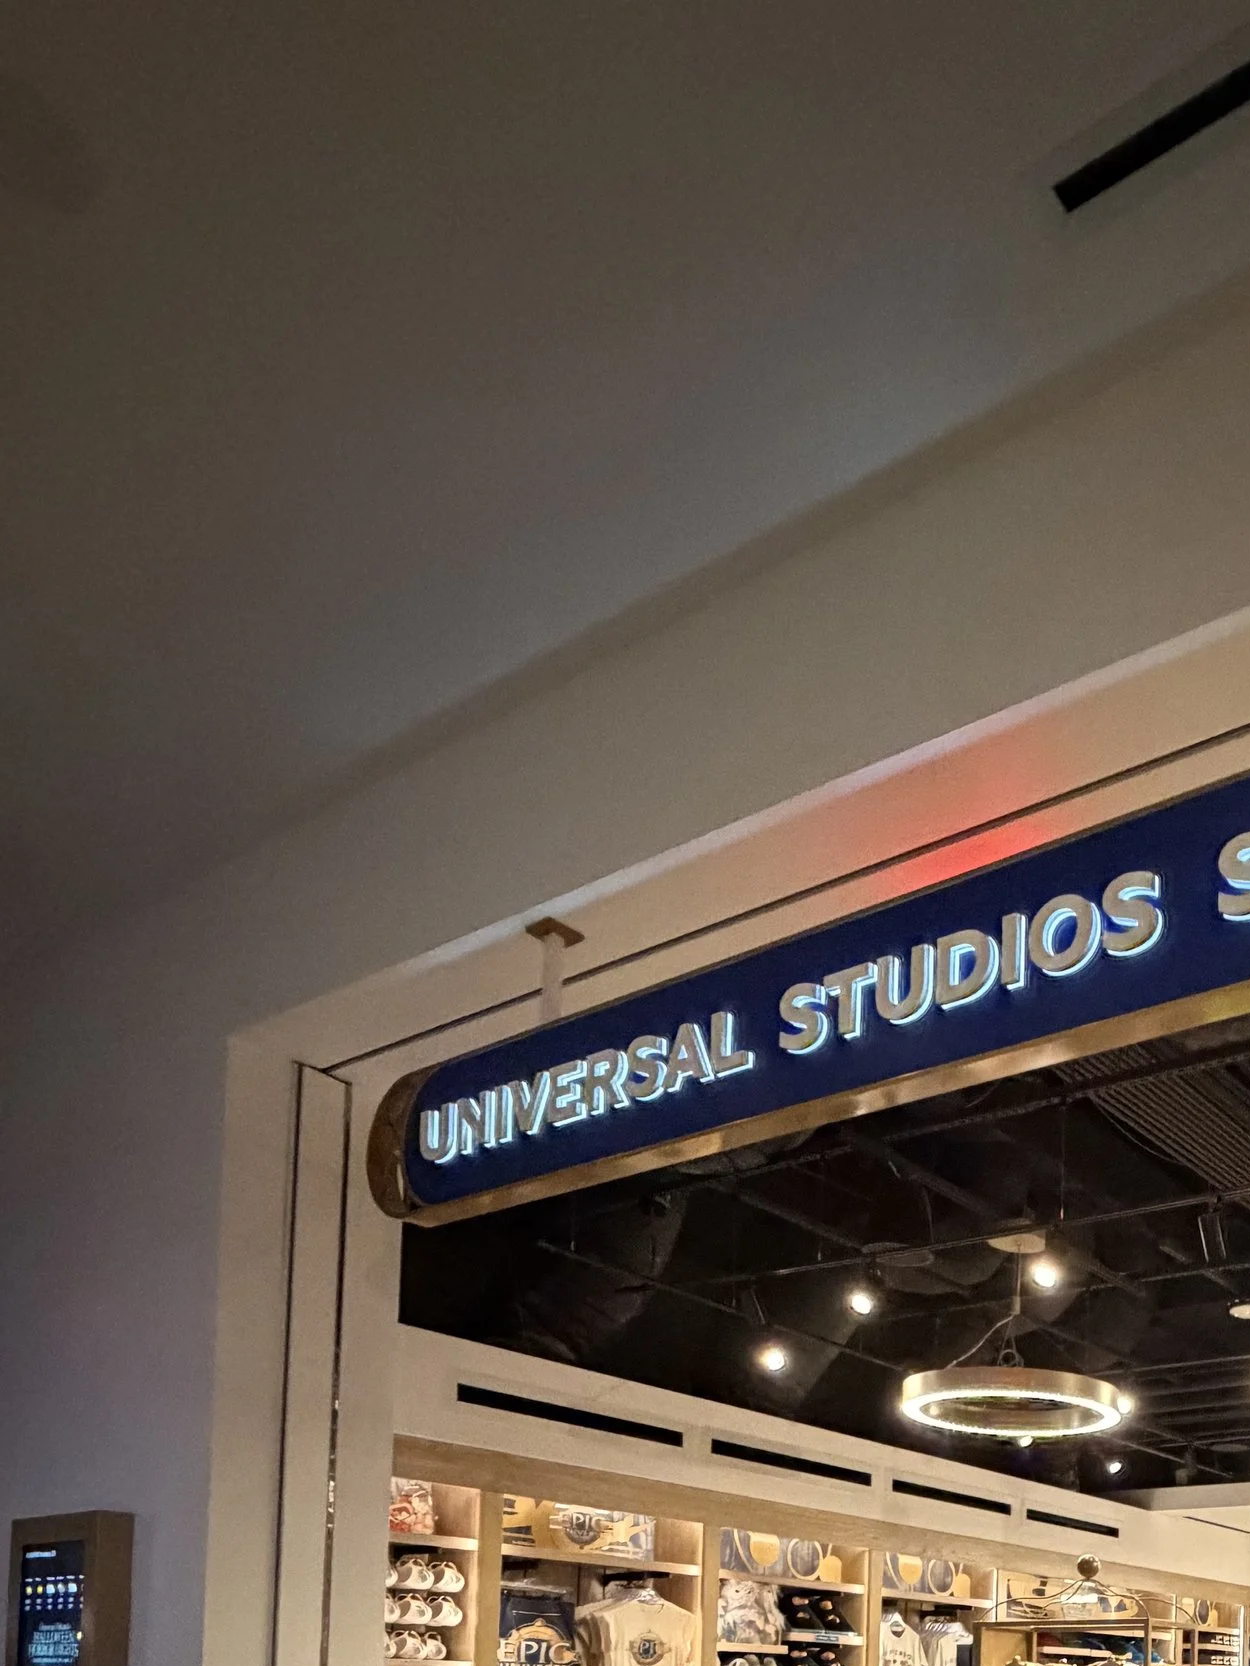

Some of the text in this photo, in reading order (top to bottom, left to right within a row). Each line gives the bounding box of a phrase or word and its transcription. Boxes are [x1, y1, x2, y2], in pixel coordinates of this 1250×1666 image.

[419, 1011, 755, 1164] UNIVERSAL
[779, 870, 1164, 1055] STUDIOS
[497, 1638, 573, 1664] EPIC
